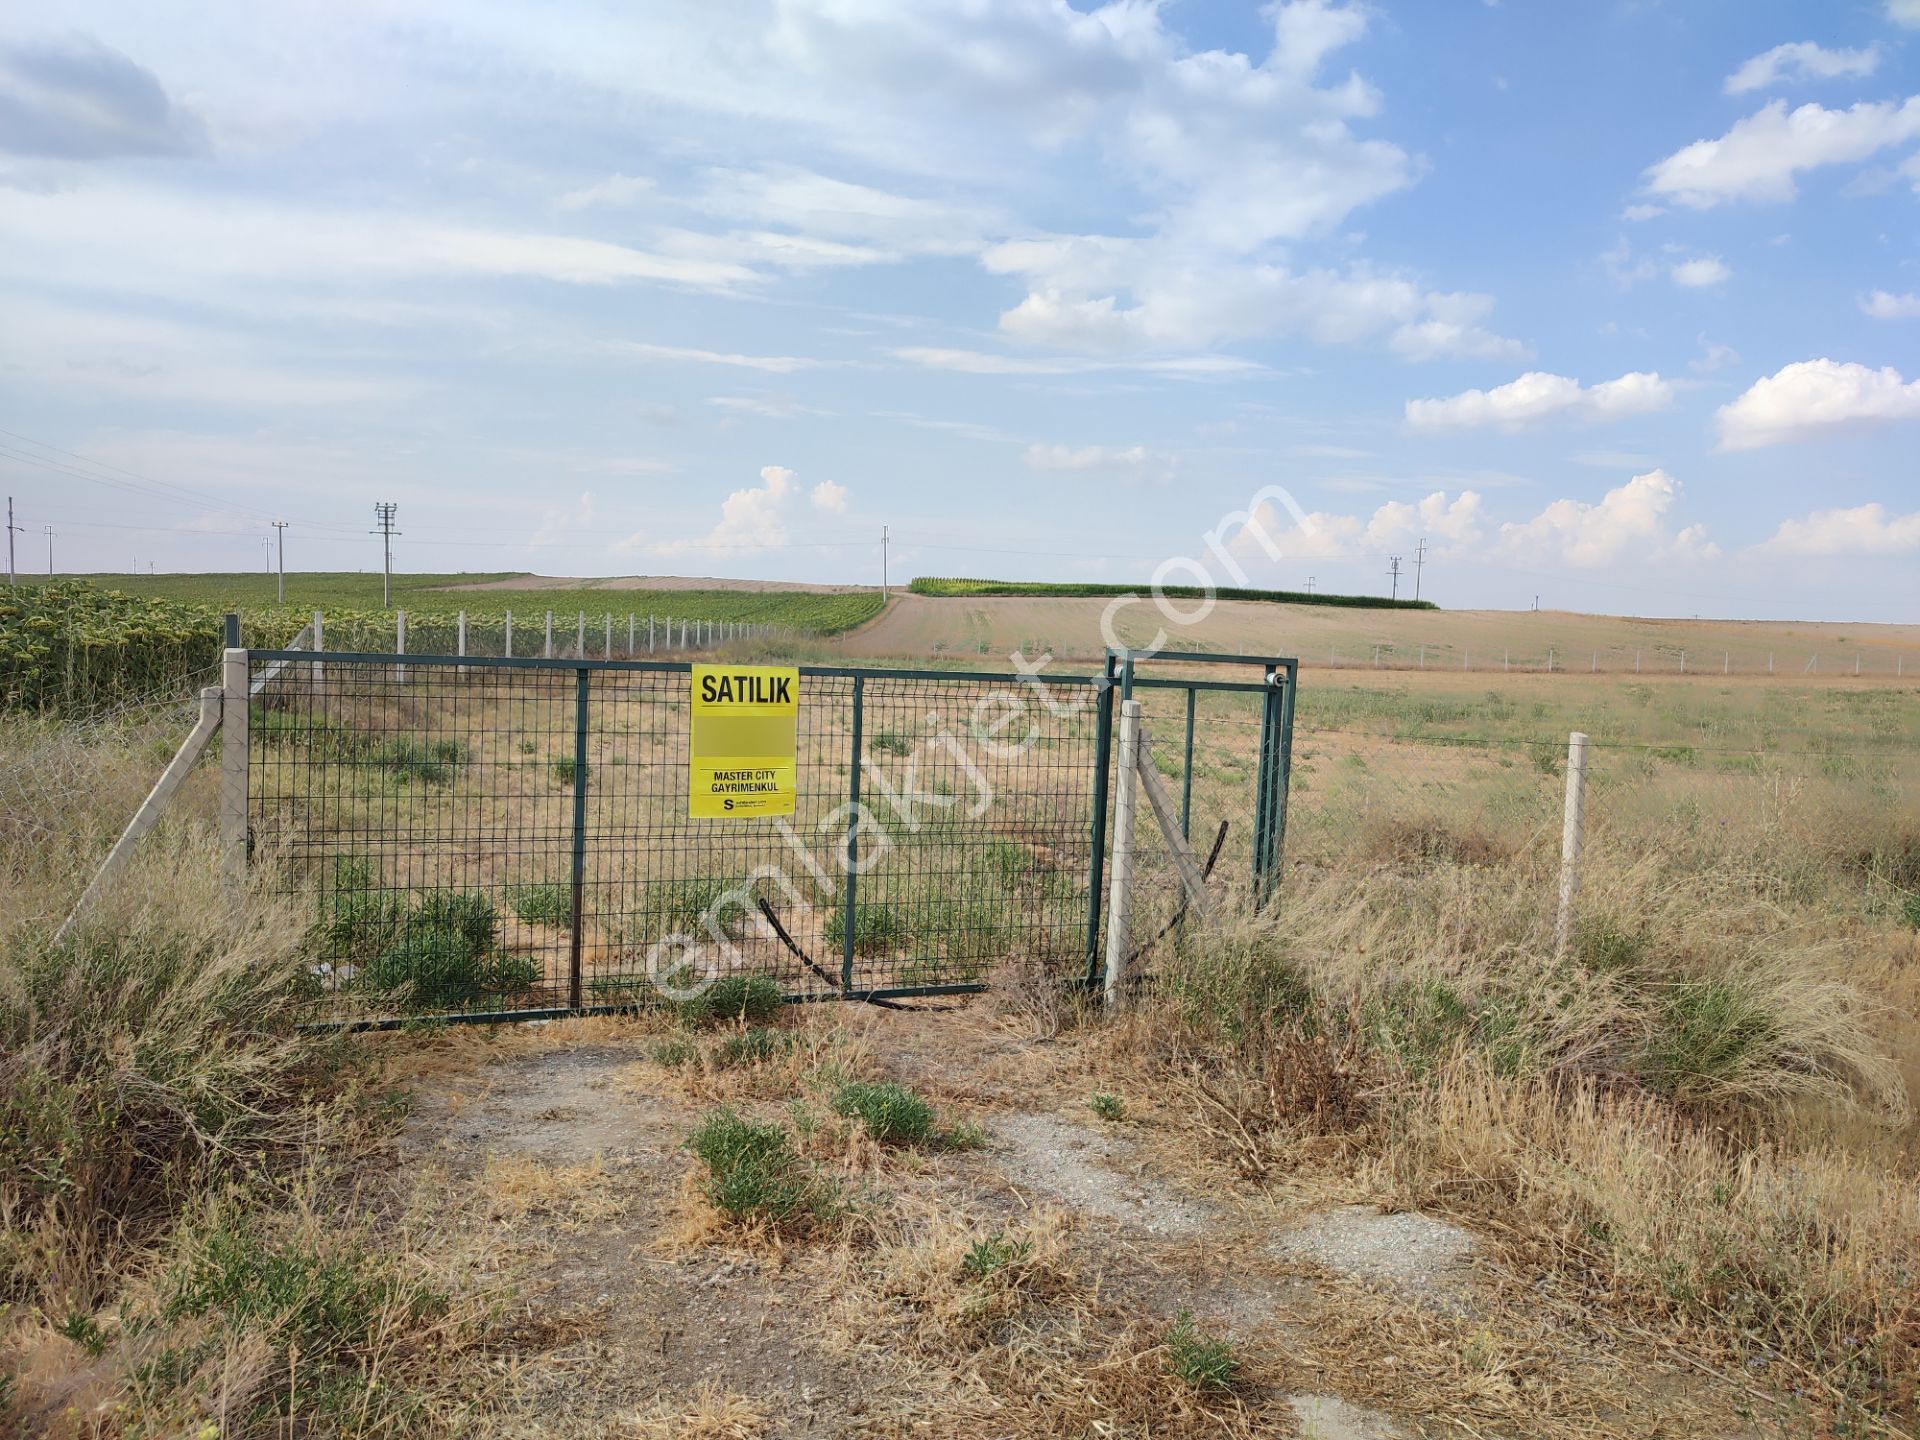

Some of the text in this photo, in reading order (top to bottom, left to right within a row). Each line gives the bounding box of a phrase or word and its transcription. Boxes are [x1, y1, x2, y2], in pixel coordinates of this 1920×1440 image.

[701, 675, 791, 704] SATILIK
[714, 770, 776, 781] MASTER CITY
[711, 781, 779, 793] GAYRİMENKUL
